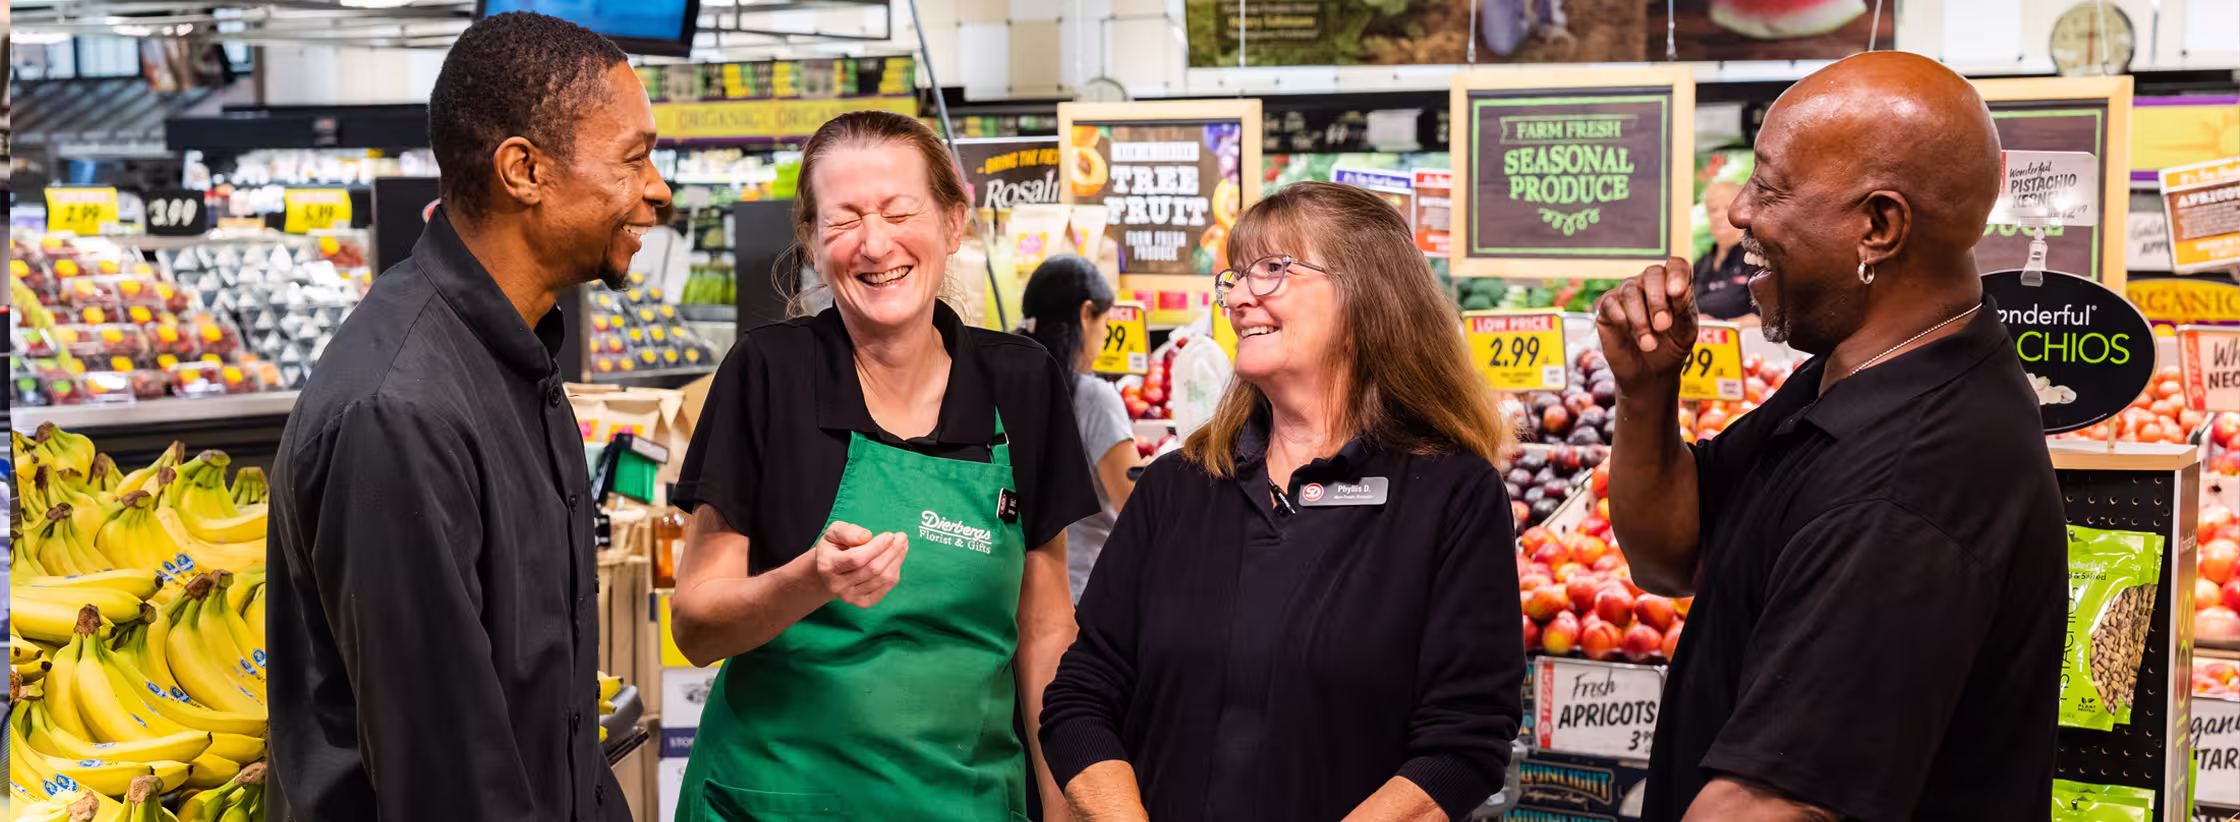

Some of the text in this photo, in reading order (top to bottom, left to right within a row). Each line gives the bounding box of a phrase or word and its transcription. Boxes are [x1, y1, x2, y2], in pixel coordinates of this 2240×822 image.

[1516, 121, 1621, 139] FARM FRESH
[1504, 144, 1635, 175] SEASONAL
[2009, 162, 2052, 179] Wonderful
[1110, 165, 1200, 195] TREE
[1509, 174, 1630, 204] PRODUCE
[2010, 173, 2077, 194] PISTACHIO
[1103, 195, 1209, 226] FRUIT
[1508, 315, 1549, 331] PRICE
[1489, 336, 1540, 368] 2.99
[2016, 331, 2130, 365] CHIOS
[1337, 484, 1361, 494] Phyllis
[921, 510, 991, 541] Dierbergs
[919, 528, 991, 555] Florist & Gifts
[1571, 668, 1618, 699] Fresh
[1558, 701, 1656, 729] APRICOTS
[2200, 747, 2240, 771] TAR
